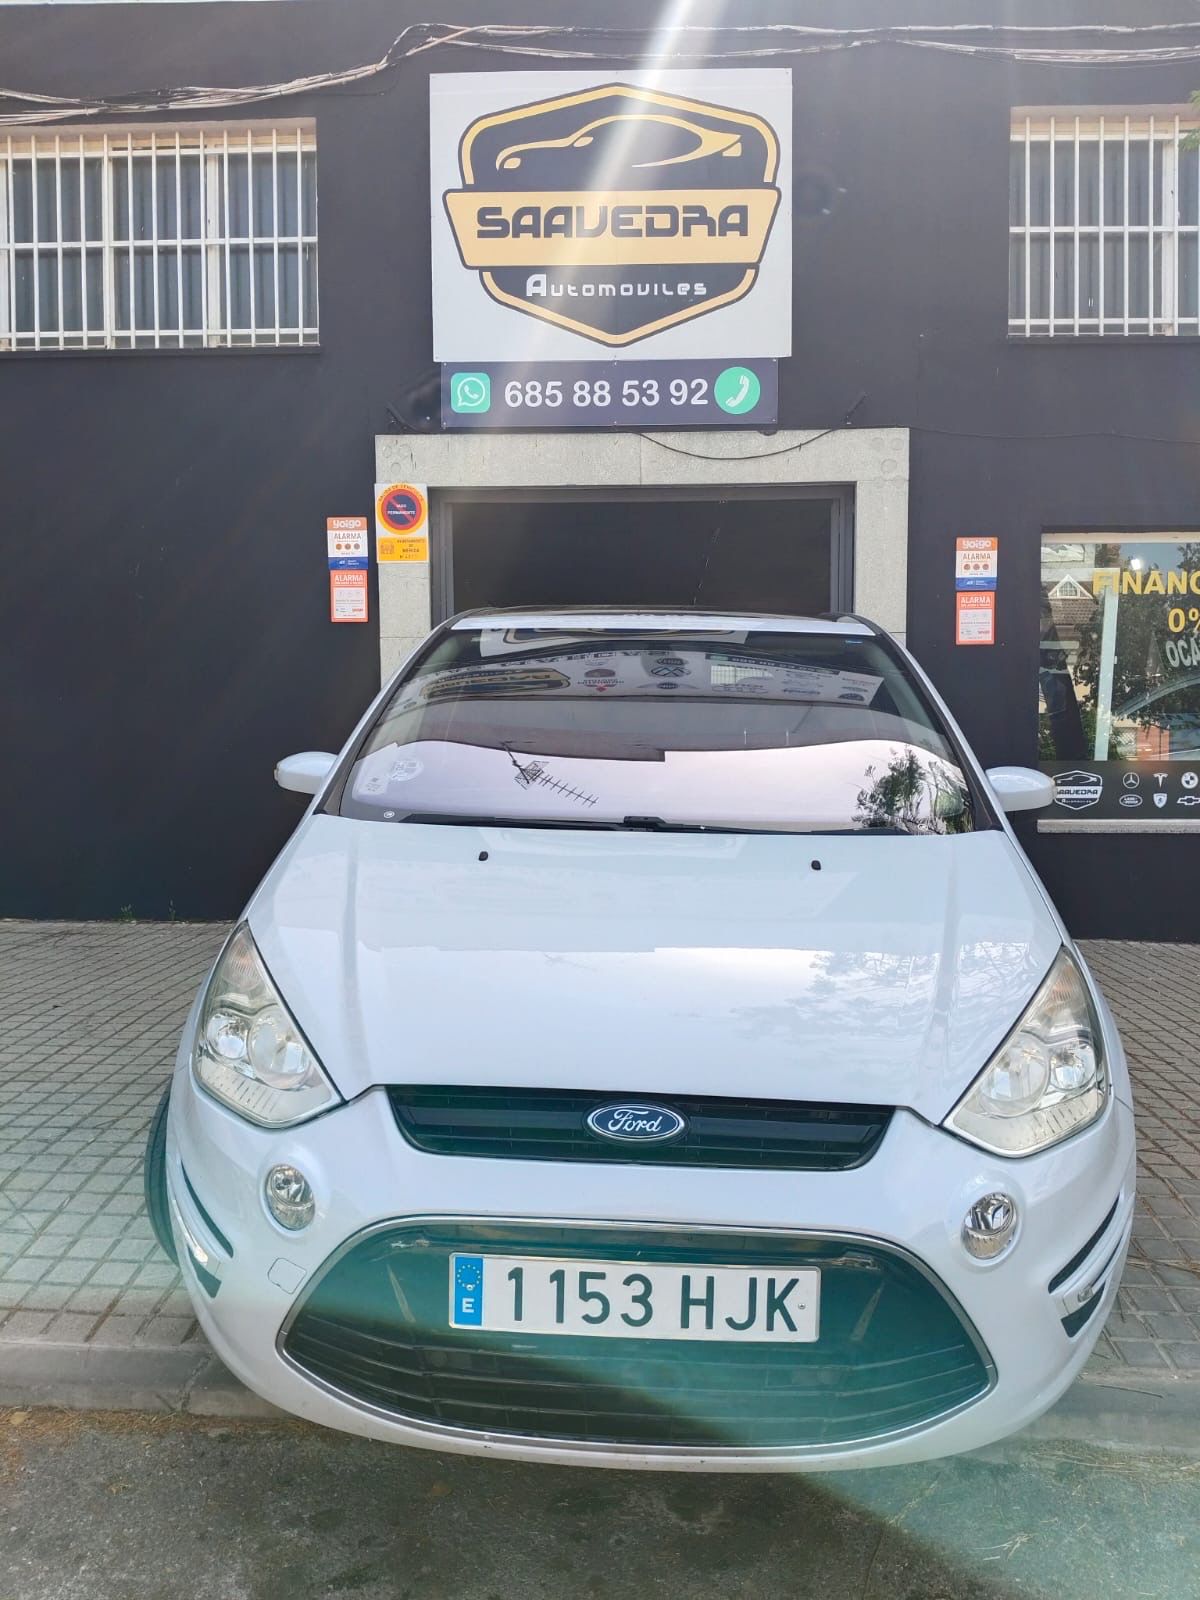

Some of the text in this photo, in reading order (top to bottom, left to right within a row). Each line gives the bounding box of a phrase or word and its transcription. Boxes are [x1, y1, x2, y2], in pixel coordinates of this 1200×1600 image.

[476, 204, 749, 239] SAAVEDRA
[504, 378, 709, 408] 685 88 53 92
[332, 519, 362, 529] yoigo
[334, 532, 361, 540] ALARMA
[962, 540, 991, 549] yoigo
[962, 552, 991, 560] ALARMA
[335, 574, 364, 582] ALARMA
[960, 595, 991, 604] ALARMA
[608, 1109, 662, 1131] Ford
[461, 1266, 800, 1333] E 1153 HJK
